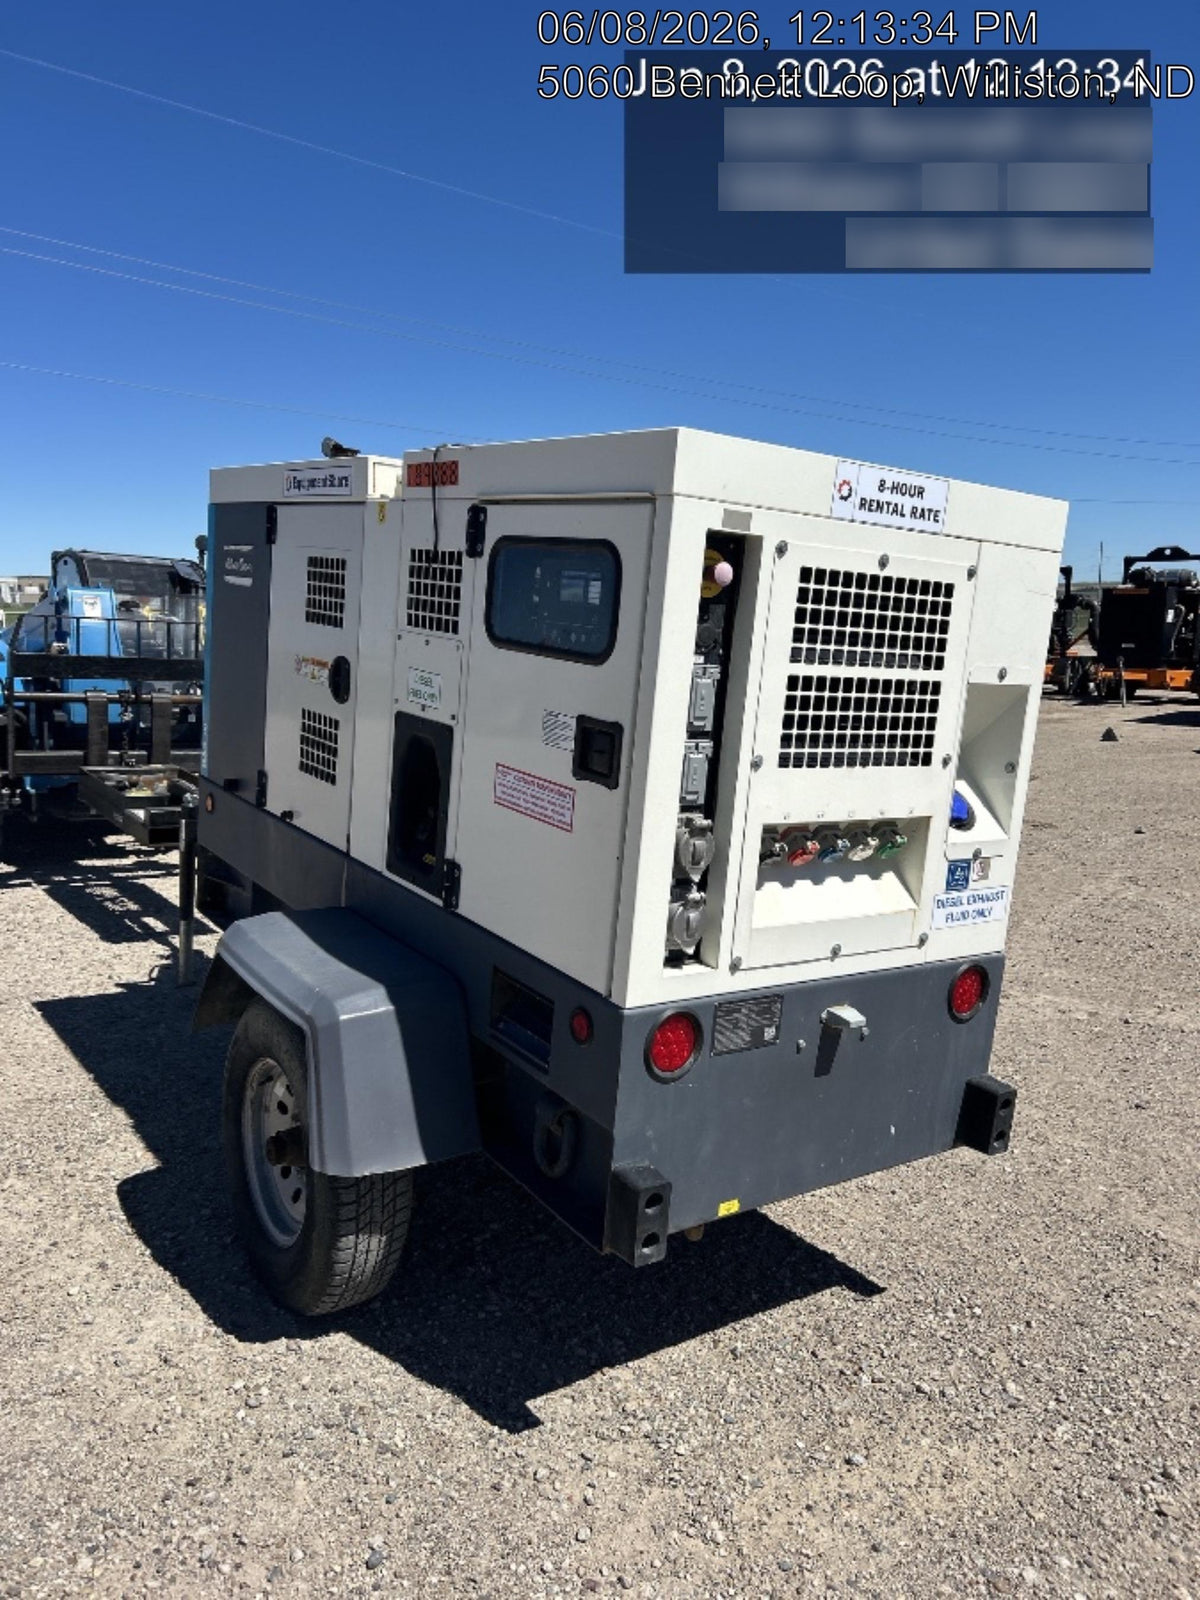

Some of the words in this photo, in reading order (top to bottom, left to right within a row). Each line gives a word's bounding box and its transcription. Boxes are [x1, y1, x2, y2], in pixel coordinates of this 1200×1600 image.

[878, 479, 926, 501] 8-HOUR
[858, 497, 906, 518] RENTAL
[909, 505, 942, 523] RATE
